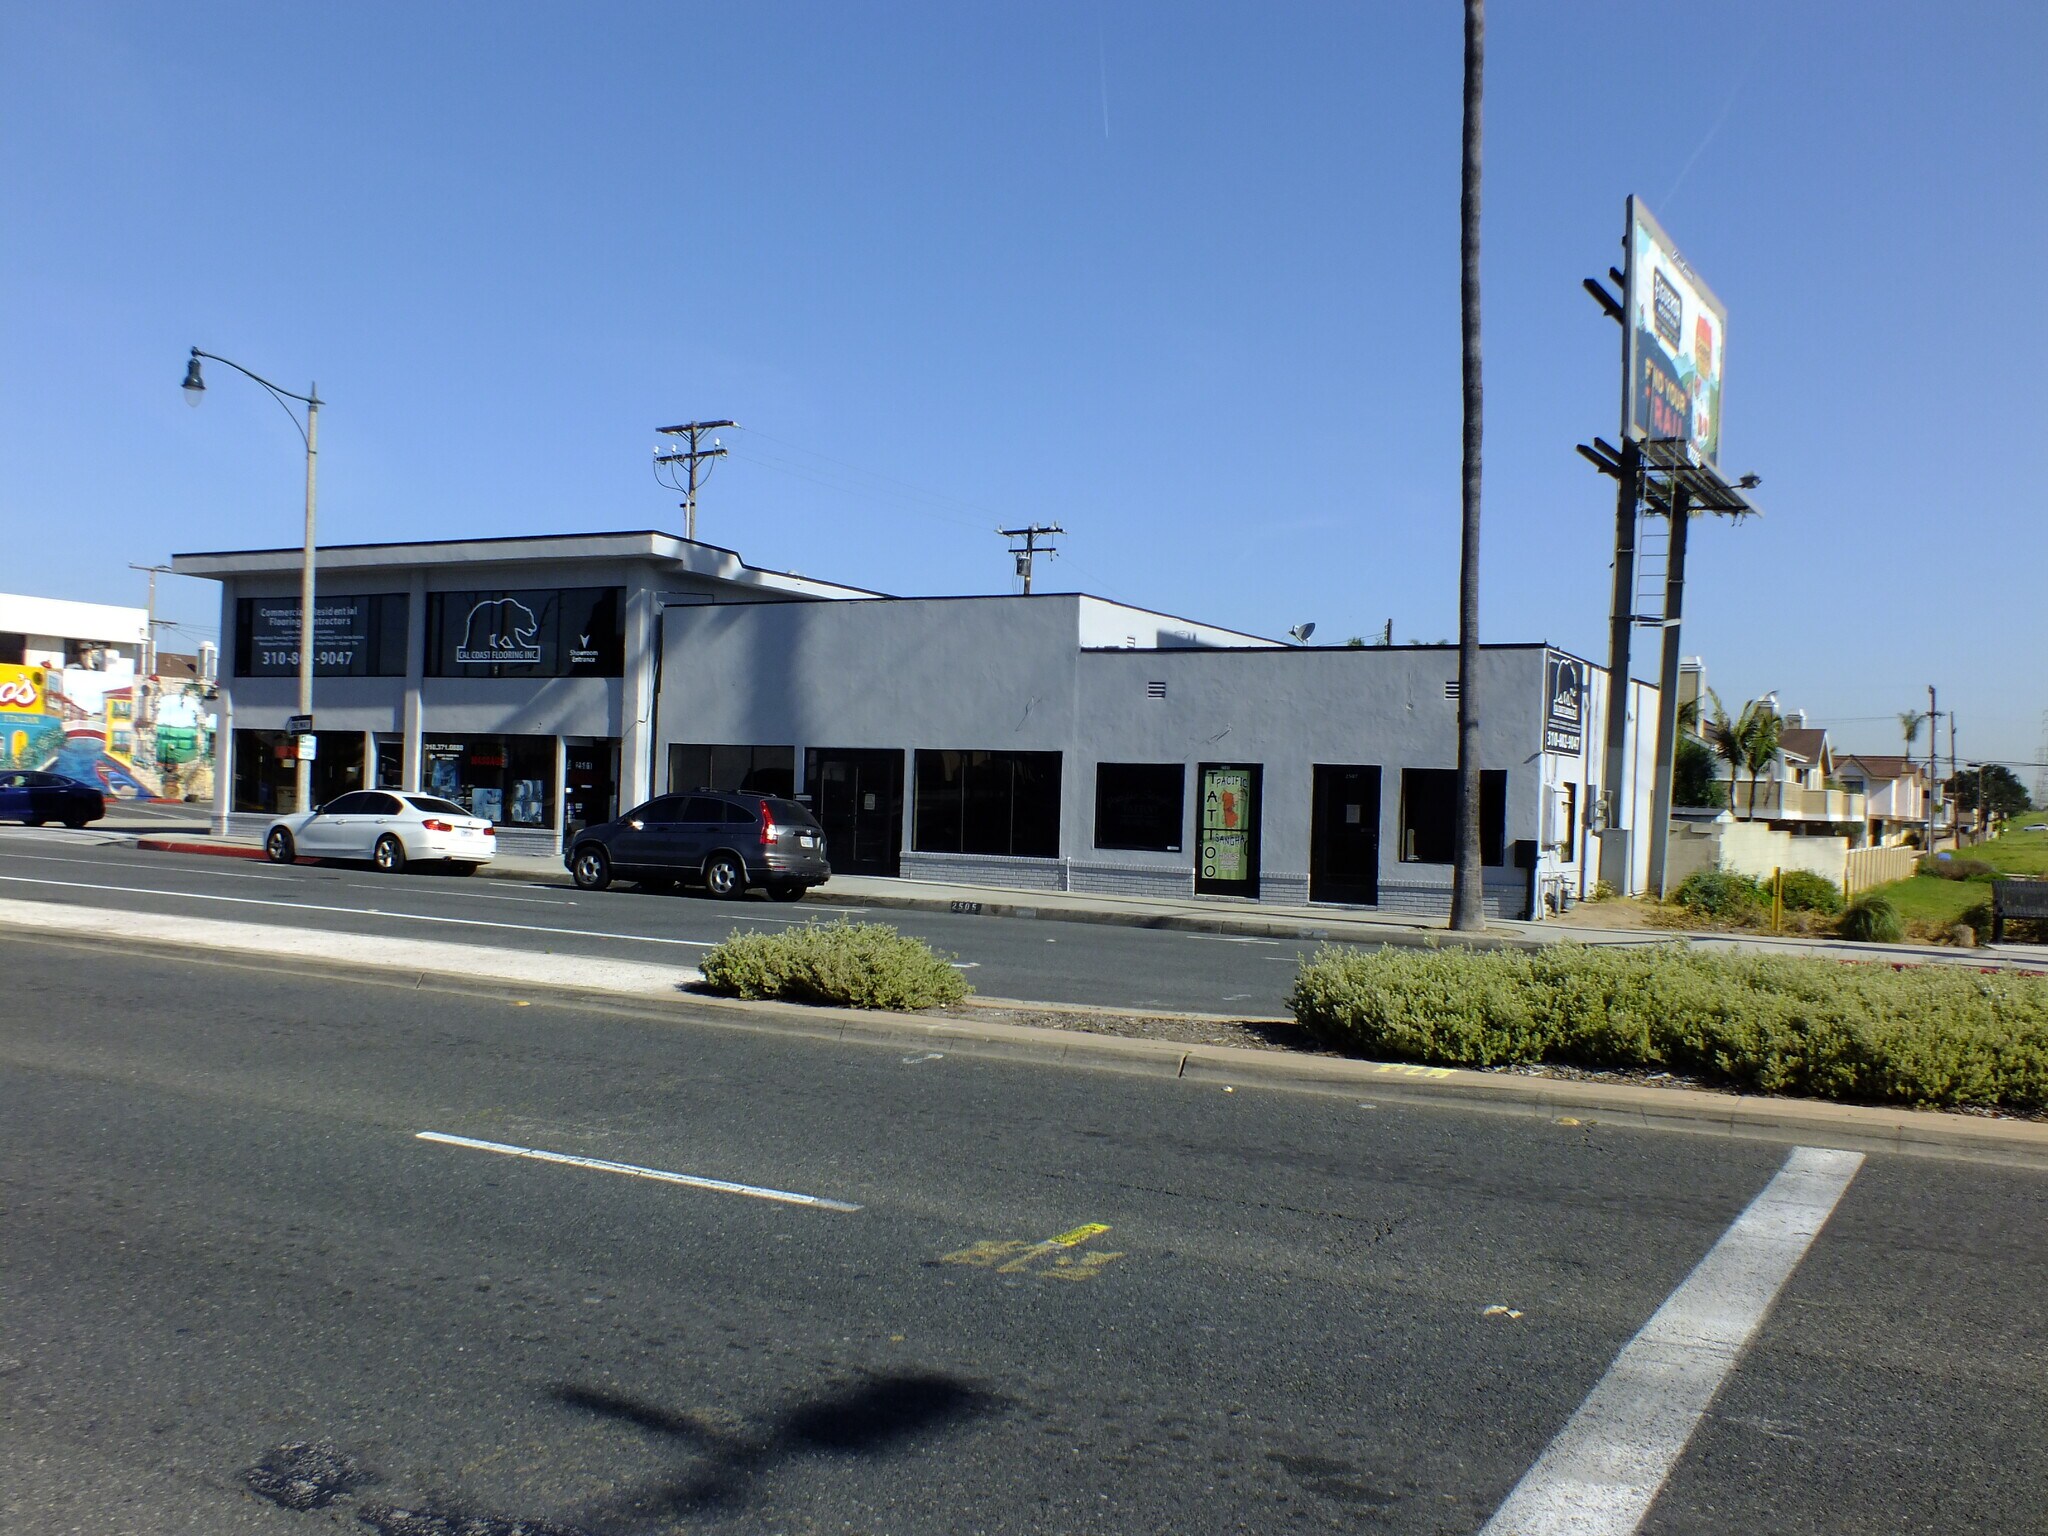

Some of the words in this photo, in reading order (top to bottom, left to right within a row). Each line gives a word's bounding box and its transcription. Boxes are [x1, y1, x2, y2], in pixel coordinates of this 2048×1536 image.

[260, 608, 304, 617] Commercia
[269, 617, 302, 628] Flooring
[459, 651, 471, 659] CAL
[471, 651, 491, 659] COAST
[492, 651, 523, 659] FLOORING
[1216, 775, 1248, 789] PACIFIC
[1204, 771, 1219, 878] TATTOO
[1215, 833, 1245, 847] SANGHA
[952, 902, 977, 911] 2505
